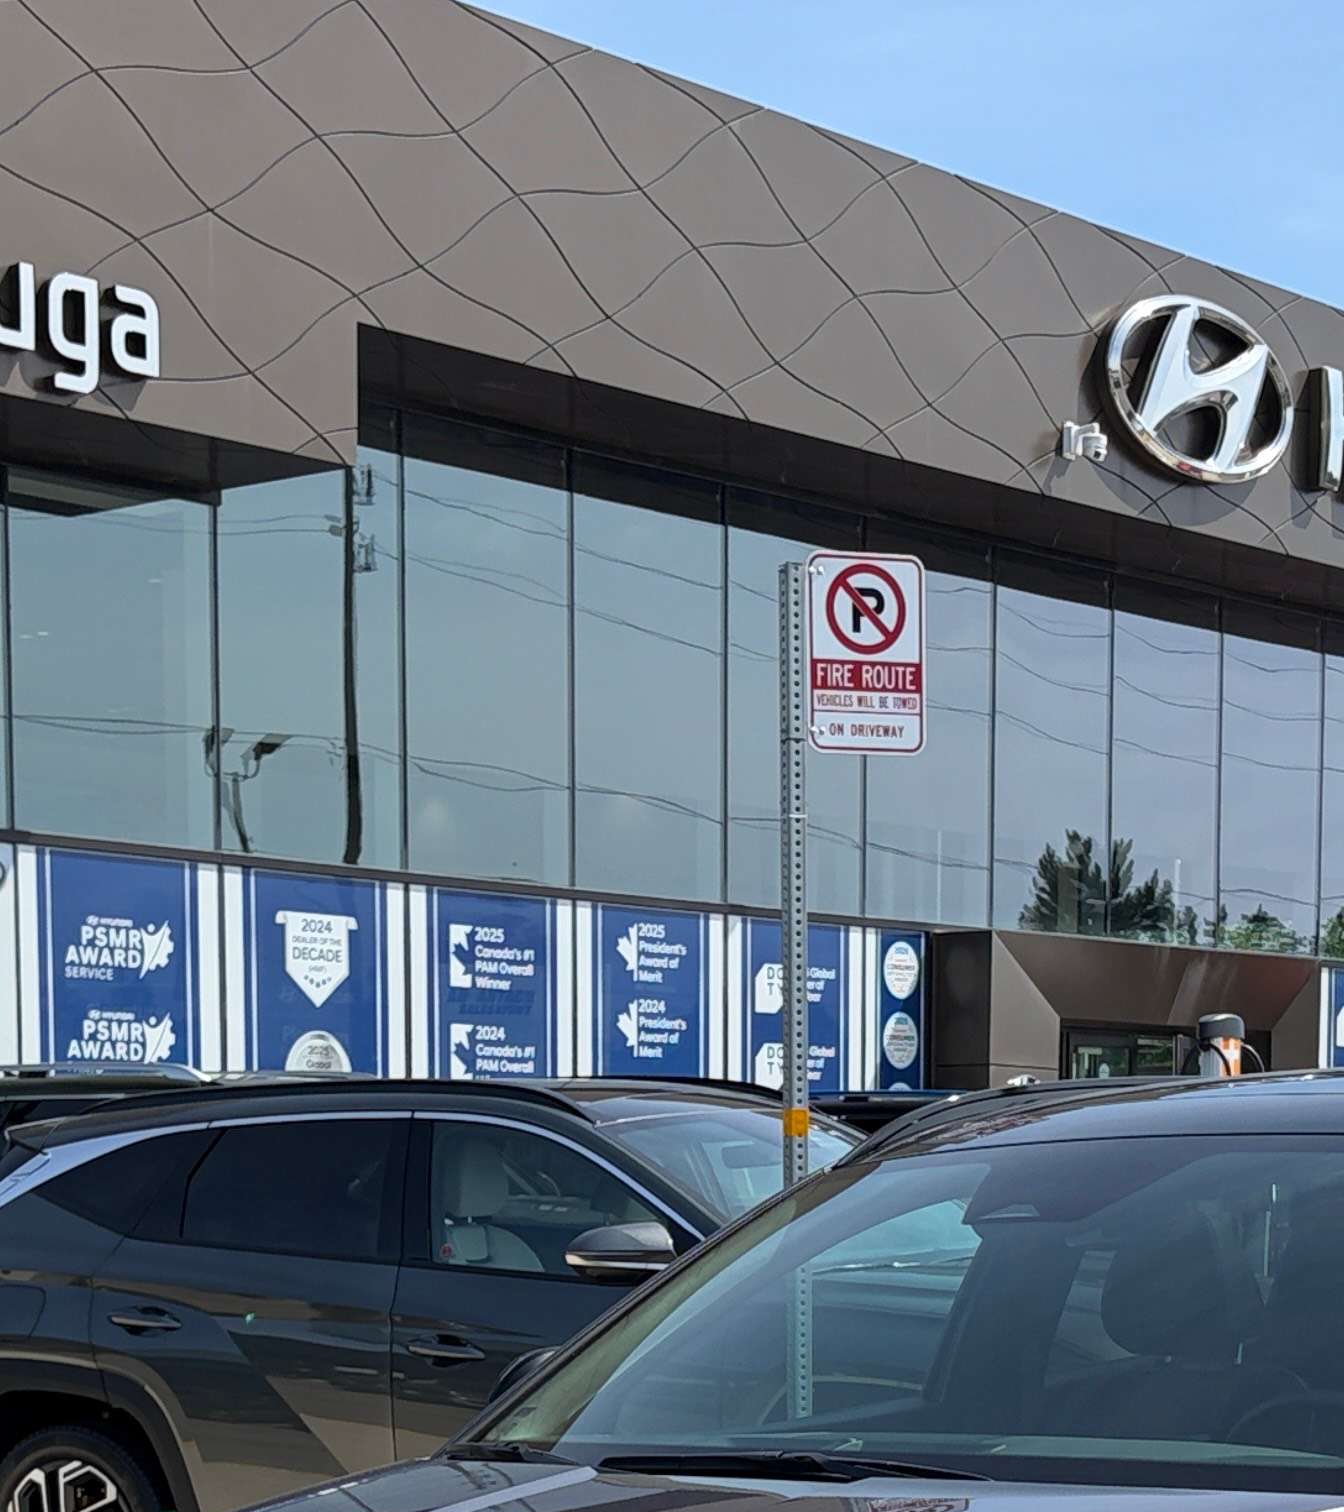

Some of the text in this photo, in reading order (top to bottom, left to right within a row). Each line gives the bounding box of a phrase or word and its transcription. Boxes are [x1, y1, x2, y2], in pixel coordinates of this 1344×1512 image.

[815, 662, 917, 691] FIRE ROUTE
[815, 693, 918, 710] VEHICLES WILL BE TOWED
[829, 722, 905, 738] ON DRIVEWAY
[301, 918, 333, 933] 2024
[638, 922, 666, 939] 2025
[80, 925, 143, 950] PSMR
[474, 926, 505, 943] 2025
[292, 946, 343, 963] DECADE
[474, 944, 522, 962] Canada's
[639, 940, 688, 956] President's
[64, 944, 143, 969] AWARD
[638, 955, 668, 969] Award
[64, 965, 115, 981] SERVICE
[474, 960, 535, 976] PAM Overall
[474, 976, 512, 991] Winner
[638, 999, 667, 1014] 2024
[82, 1019, 144, 1043] PSMR
[639, 1016, 688, 1031] President's
[474, 1025, 506, 1041] 2024
[638, 1031, 669, 1044] Award
[66, 1039, 144, 1062] AWARD
[475, 1043, 523, 1059] Canada's
[475, 1058, 535, 1074] PAM Overall
